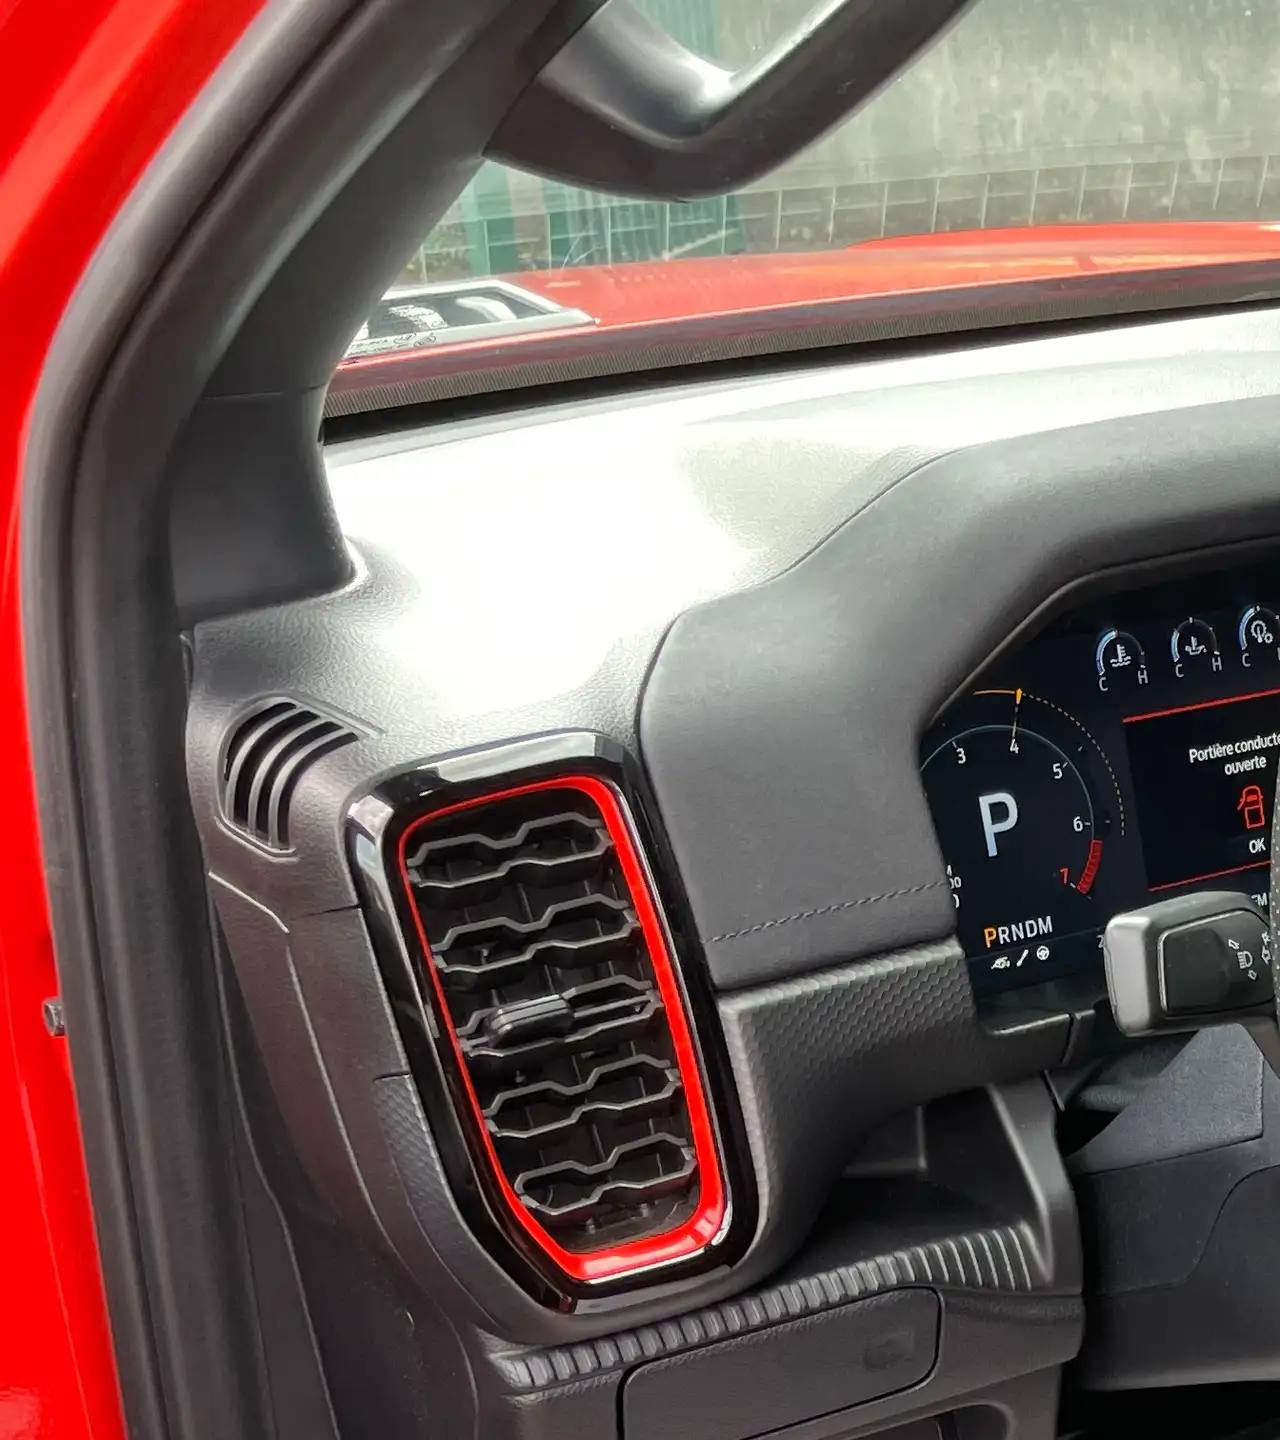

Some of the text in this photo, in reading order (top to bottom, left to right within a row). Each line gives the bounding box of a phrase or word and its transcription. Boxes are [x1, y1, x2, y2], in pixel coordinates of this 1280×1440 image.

[1212, 657, 1222, 672] H
[1242, 653, 1251, 667] C
[1138, 669, 1148, 684] H
[1175, 664, 1184, 678] C
[1099, 677, 1108, 692] C
[1010, 739, 1019, 754] 4
[1189, 737, 1234, 763] Portière
[956, 747, 966, 764] 3
[1053, 763, 1063, 779] 5
[1224, 755, 1267, 776] ouverte
[978, 792, 1018, 858] P
[1073, 816, 1083, 832] 6
[1249, 837, 1266, 854] OK
[1059, 868, 1068, 884] 7
